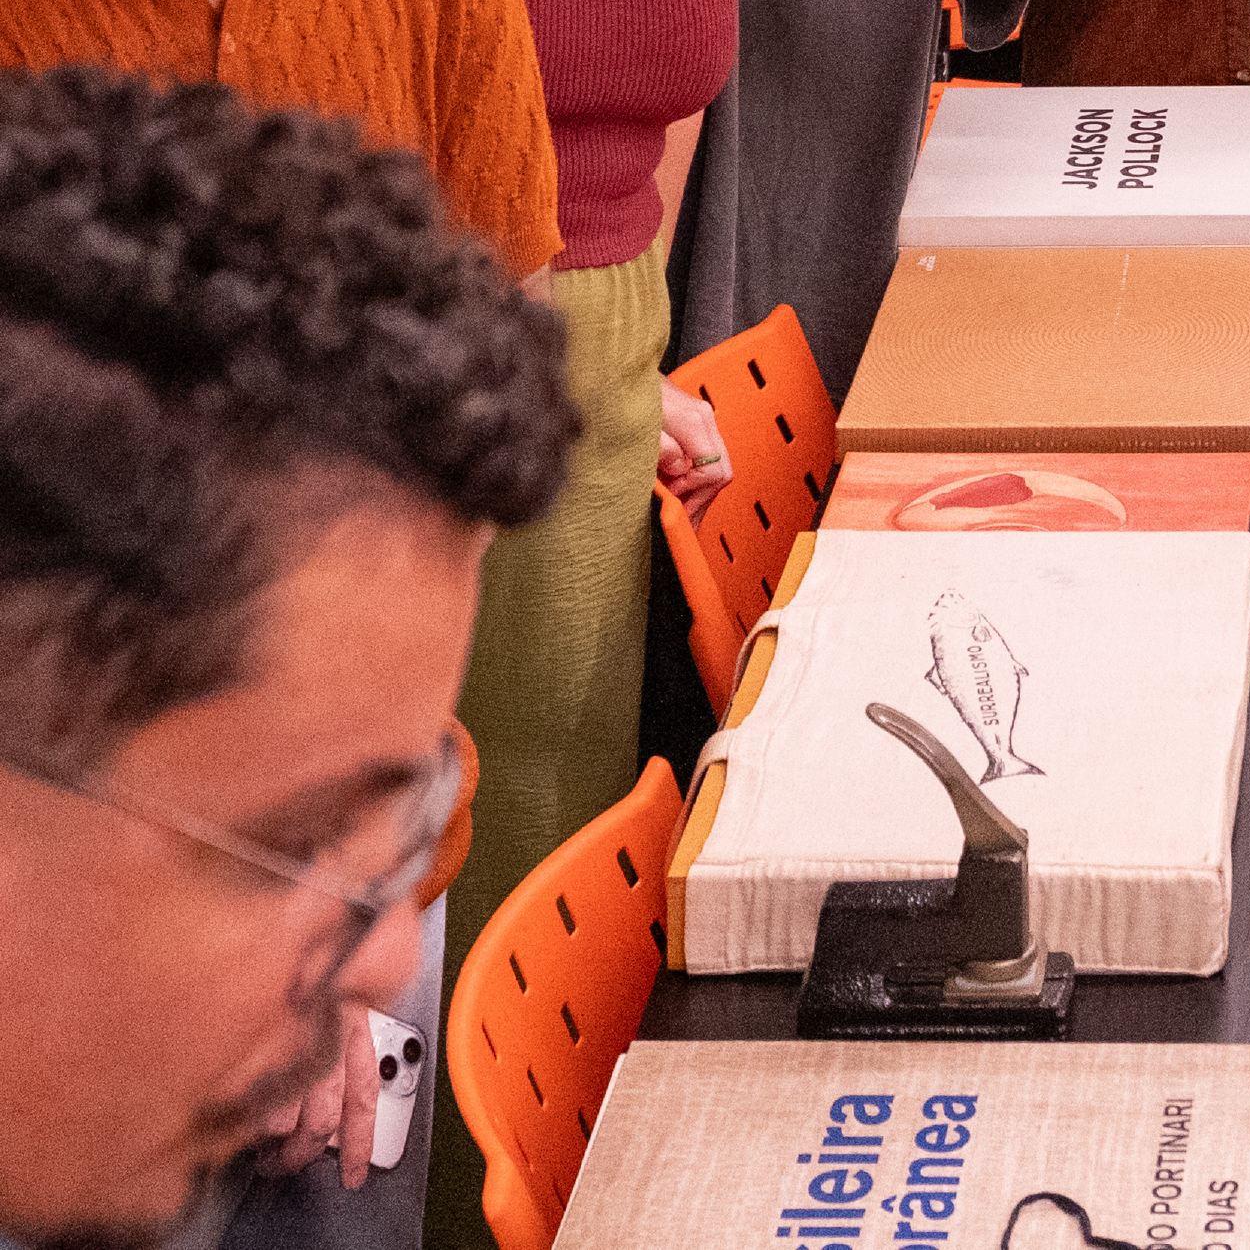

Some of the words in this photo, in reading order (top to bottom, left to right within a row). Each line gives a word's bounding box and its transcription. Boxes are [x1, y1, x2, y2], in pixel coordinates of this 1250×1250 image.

[1062, 109, 1114, 189] JACKSON
[1117, 108, 1168, 189] POLLOCK
[966, 645, 1000, 726] SURREALISMO
[774, 1095, 895, 1250] ileira
[880, 1095, 979, 1250] rânea
[1150, 1098, 1194, 1215] PORTINARI
[1203, 1180, 1239, 1234] DIAS
